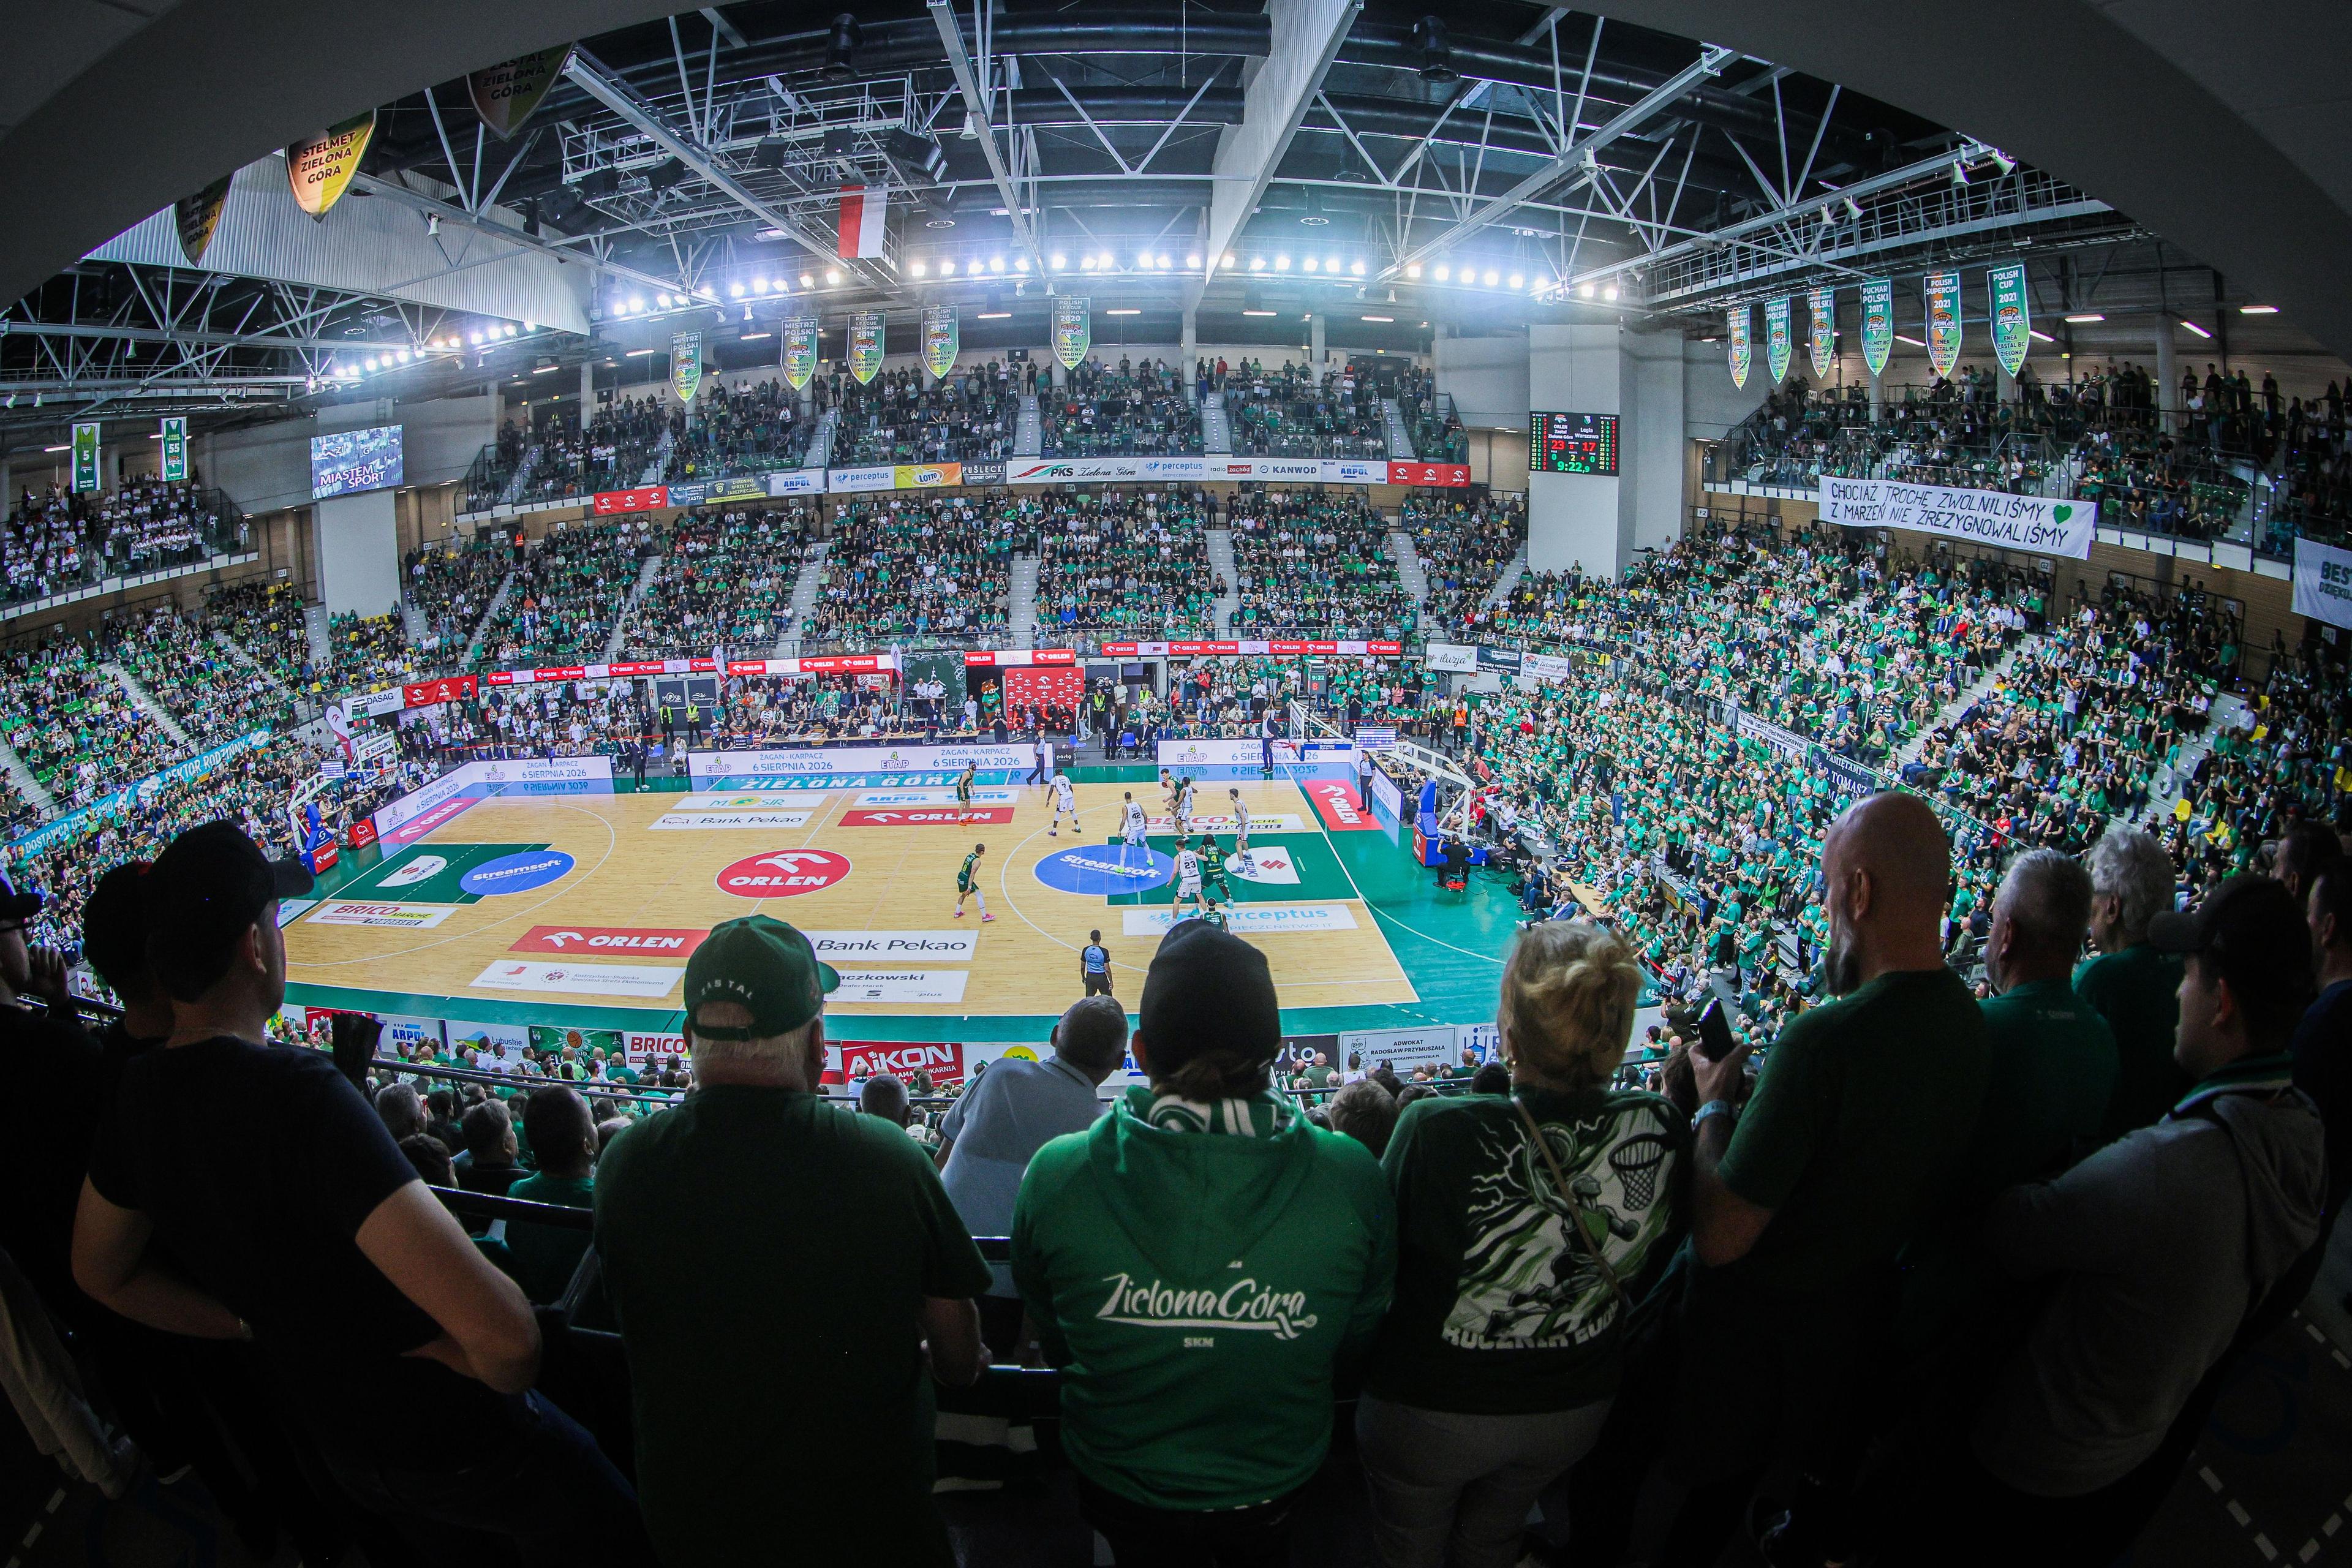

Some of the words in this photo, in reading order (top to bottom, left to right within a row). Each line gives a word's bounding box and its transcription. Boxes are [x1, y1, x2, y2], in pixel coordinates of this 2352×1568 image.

[482, 64, 546, 88] ZIELONA
[303, 132, 355, 158] STELMET
[301, 147, 352, 173] ZIELONA
[307, 165, 341, 184] GÓRA
[1993, 270, 2019, 281] POLISH
[1863, 285, 1888, 295] PUCHAR
[1926, 286, 1957, 295] SUPERCUP
[1999, 281, 2014, 289] CUP
[1863, 293, 1888, 303] POLSKI
[1999, 292, 2017, 303] 2021
[1809, 300, 1831, 309] POLSKI
[1868, 304, 1883, 313] 2017
[1934, 300, 1951, 308] 2021
[1767, 311, 1788, 320] POLSKI
[1730, 319, 1747, 328] POLSKI
[785, 328, 813, 336] POLSKI
[673, 335, 699, 344] MISTRZ
[673, 342, 698, 352] POLSKI
[168, 443, 180, 453] 55
[1551, 440, 1565, 450] 23
[1582, 442, 1596, 451] 17
[83, 450, 90, 461] 5
[962, 465, 1005, 473] PUŚLECKI
[1050, 467, 1073, 477] PKS
[1077, 467, 1112, 477] Zielona
[1116, 466, 1136, 476] Góra
[1163, 462, 1202, 472] perceptus
[320, 464, 374, 486] MIASTEM
[349, 470, 386, 489] SPORT
[850, 472, 889, 482] perceptus
[919, 472, 937, 483] LOTTO
[1831, 482, 1878, 501] CHOCIAŻ
[1885, 486, 1931, 508] TROCHĘ
[1937, 492, 2046, 521] ZWOLNILIŚMY
[1831, 502, 1838, 519] Z
[1844, 503, 1887, 521] MARZEŃ
[1889, 508, 1909, 524] NIE
[1917, 510, 2068, 548] ZREZYGNOWALIŚMY
[2320, 561, 2352, 586] BES
[1439, 653, 1466, 668] iluzja
[366, 692, 394, 705] DASAG
[1755, 721, 1766, 732] JEST
[371, 741, 390, 754] SUZUKI
[994, 757, 1020, 766] 2026
[1177, 753, 1207, 763] ETAP
[1232, 752, 1237, 761] 6
[706, 764, 731, 773] ETAP
[761, 763, 805, 771] SIERPNIA
[881, 760, 909, 769] ETAP
[1826, 753, 1863, 776] PAMIĘTAMY
[165, 761, 201, 782] SEKTOR
[419, 787, 434, 798] ŻAGAŃ
[435, 775, 453, 792] KARPACZ
[740, 777, 866, 790] ZIELONA
[1831, 771, 1868, 793] TOMASZ
[421, 791, 445, 809] SIERPNIA
[445, 782, 459, 797] 2026
[420, 802, 464, 826] ORLEN
[1329, 797, 1362, 824] ORLEN
[387, 812, 404, 828] ETAP
[25, 823, 70, 854] DOSTAWCA
[323, 848, 336, 860] ORLEN
[409, 861, 441, 881] SUZUKI
[472, 859, 562, 881] Streamsoft
[728, 876, 828, 886] ORLEN
[333, 905, 401, 915] BRICO
[1224, 908, 1328, 921] erceptus
[587, 935, 685, 949] ORLEN
[816, 940, 881, 951] Bank
[888, 940, 967, 951] Pekao
[701, 979, 753, 1001] ZASTAL
[492, 1036, 522, 1047] Lubuskie
[630, 1036, 687, 1053] BRICO
[1184, 1337, 1214, 1348] SKM
